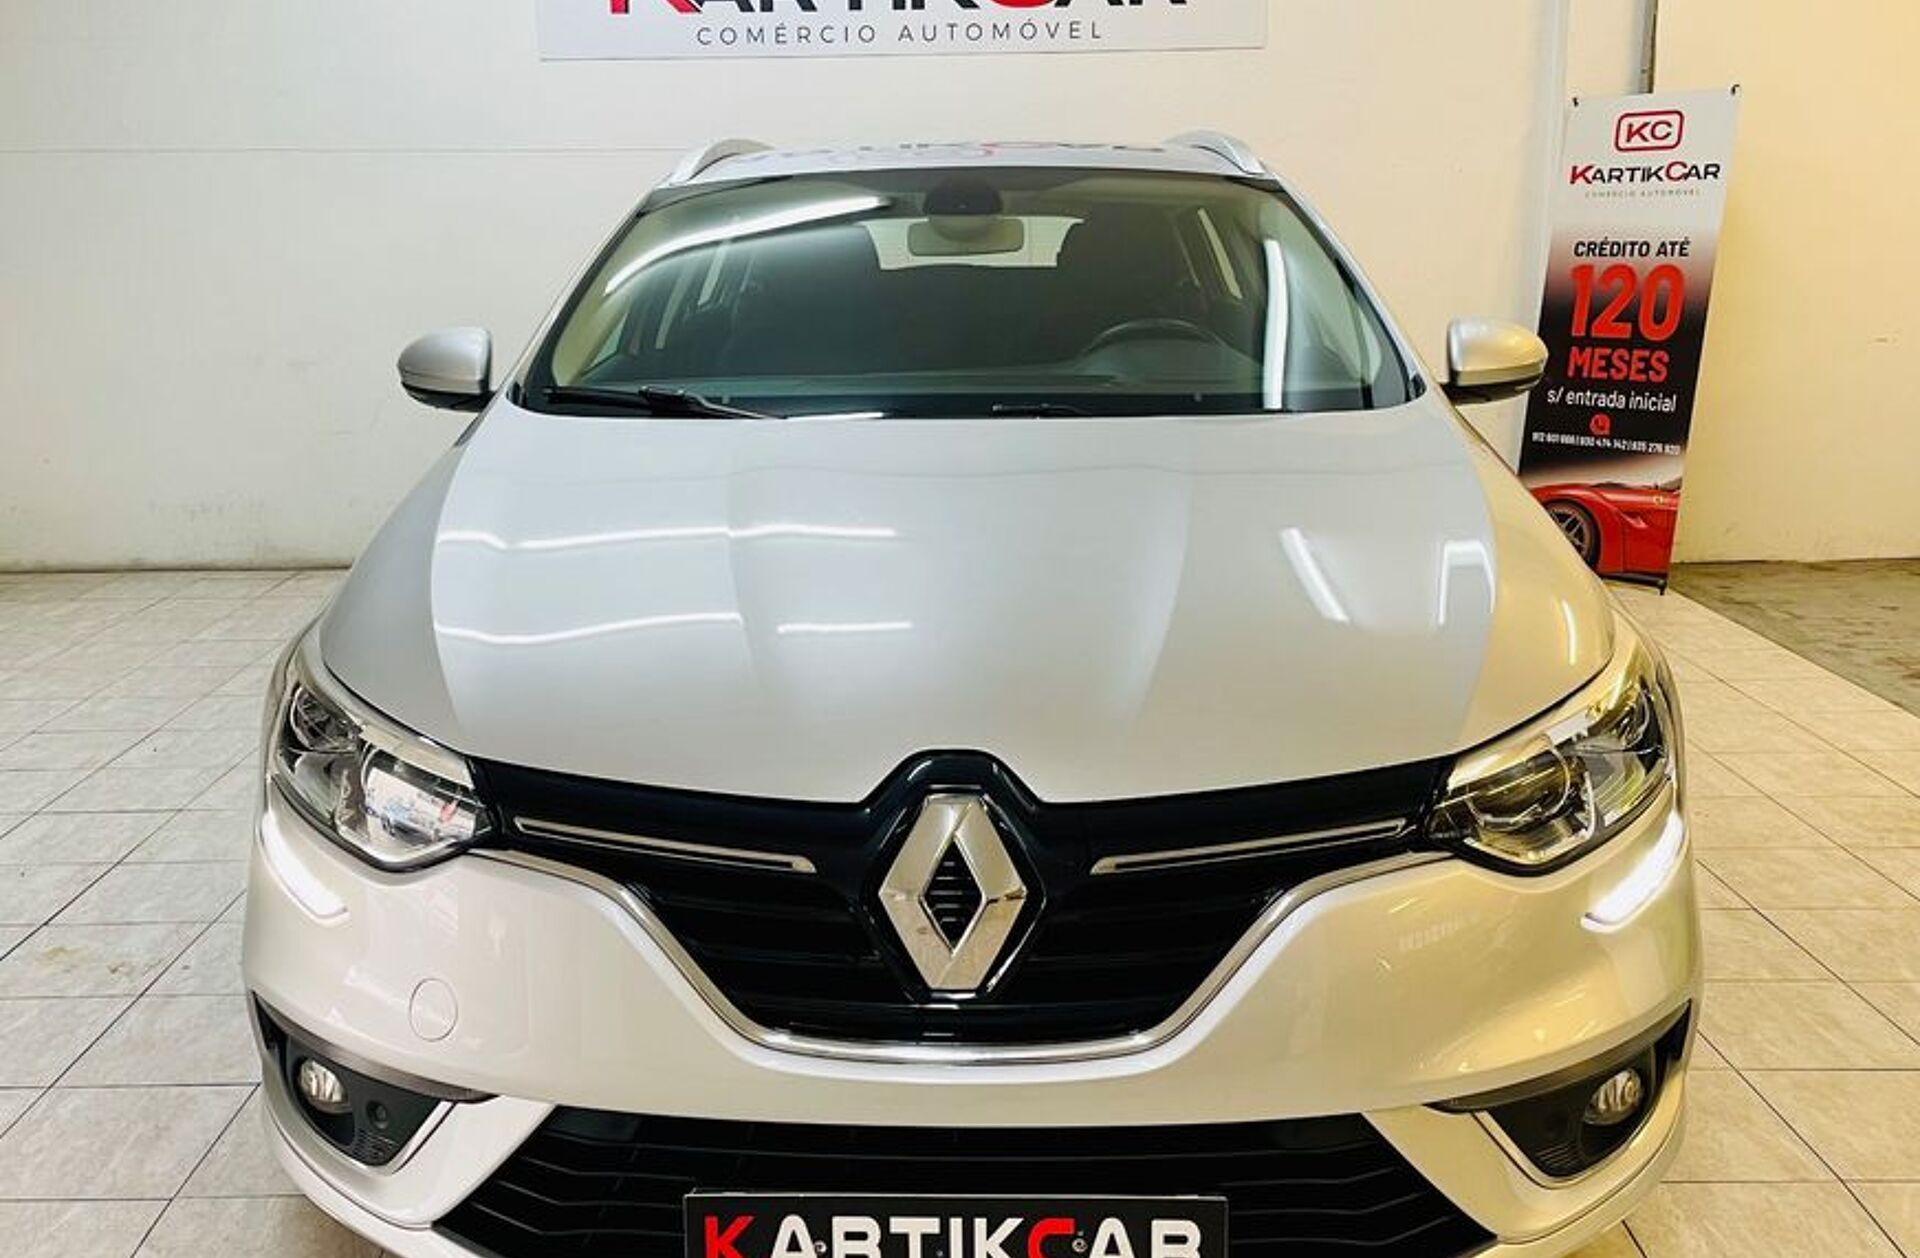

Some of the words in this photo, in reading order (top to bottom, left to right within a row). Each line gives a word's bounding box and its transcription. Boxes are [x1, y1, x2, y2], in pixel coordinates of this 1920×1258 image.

[697, 23, 876, 45] COMÉRCIO
[898, 18, 1102, 42] AUTOMÓVEL
[1625, 120, 1673, 143] KC
[1574, 236, 1651, 258] CRÉDITO
[1655, 236, 1692, 258] ATÉ
[1571, 262, 1686, 341] 120
[1567, 346, 1671, 383] MESES
[1547, 386, 1564, 404] s/
[1566, 389, 1626, 410] entrada
[1629, 390, 1677, 413] inicial
